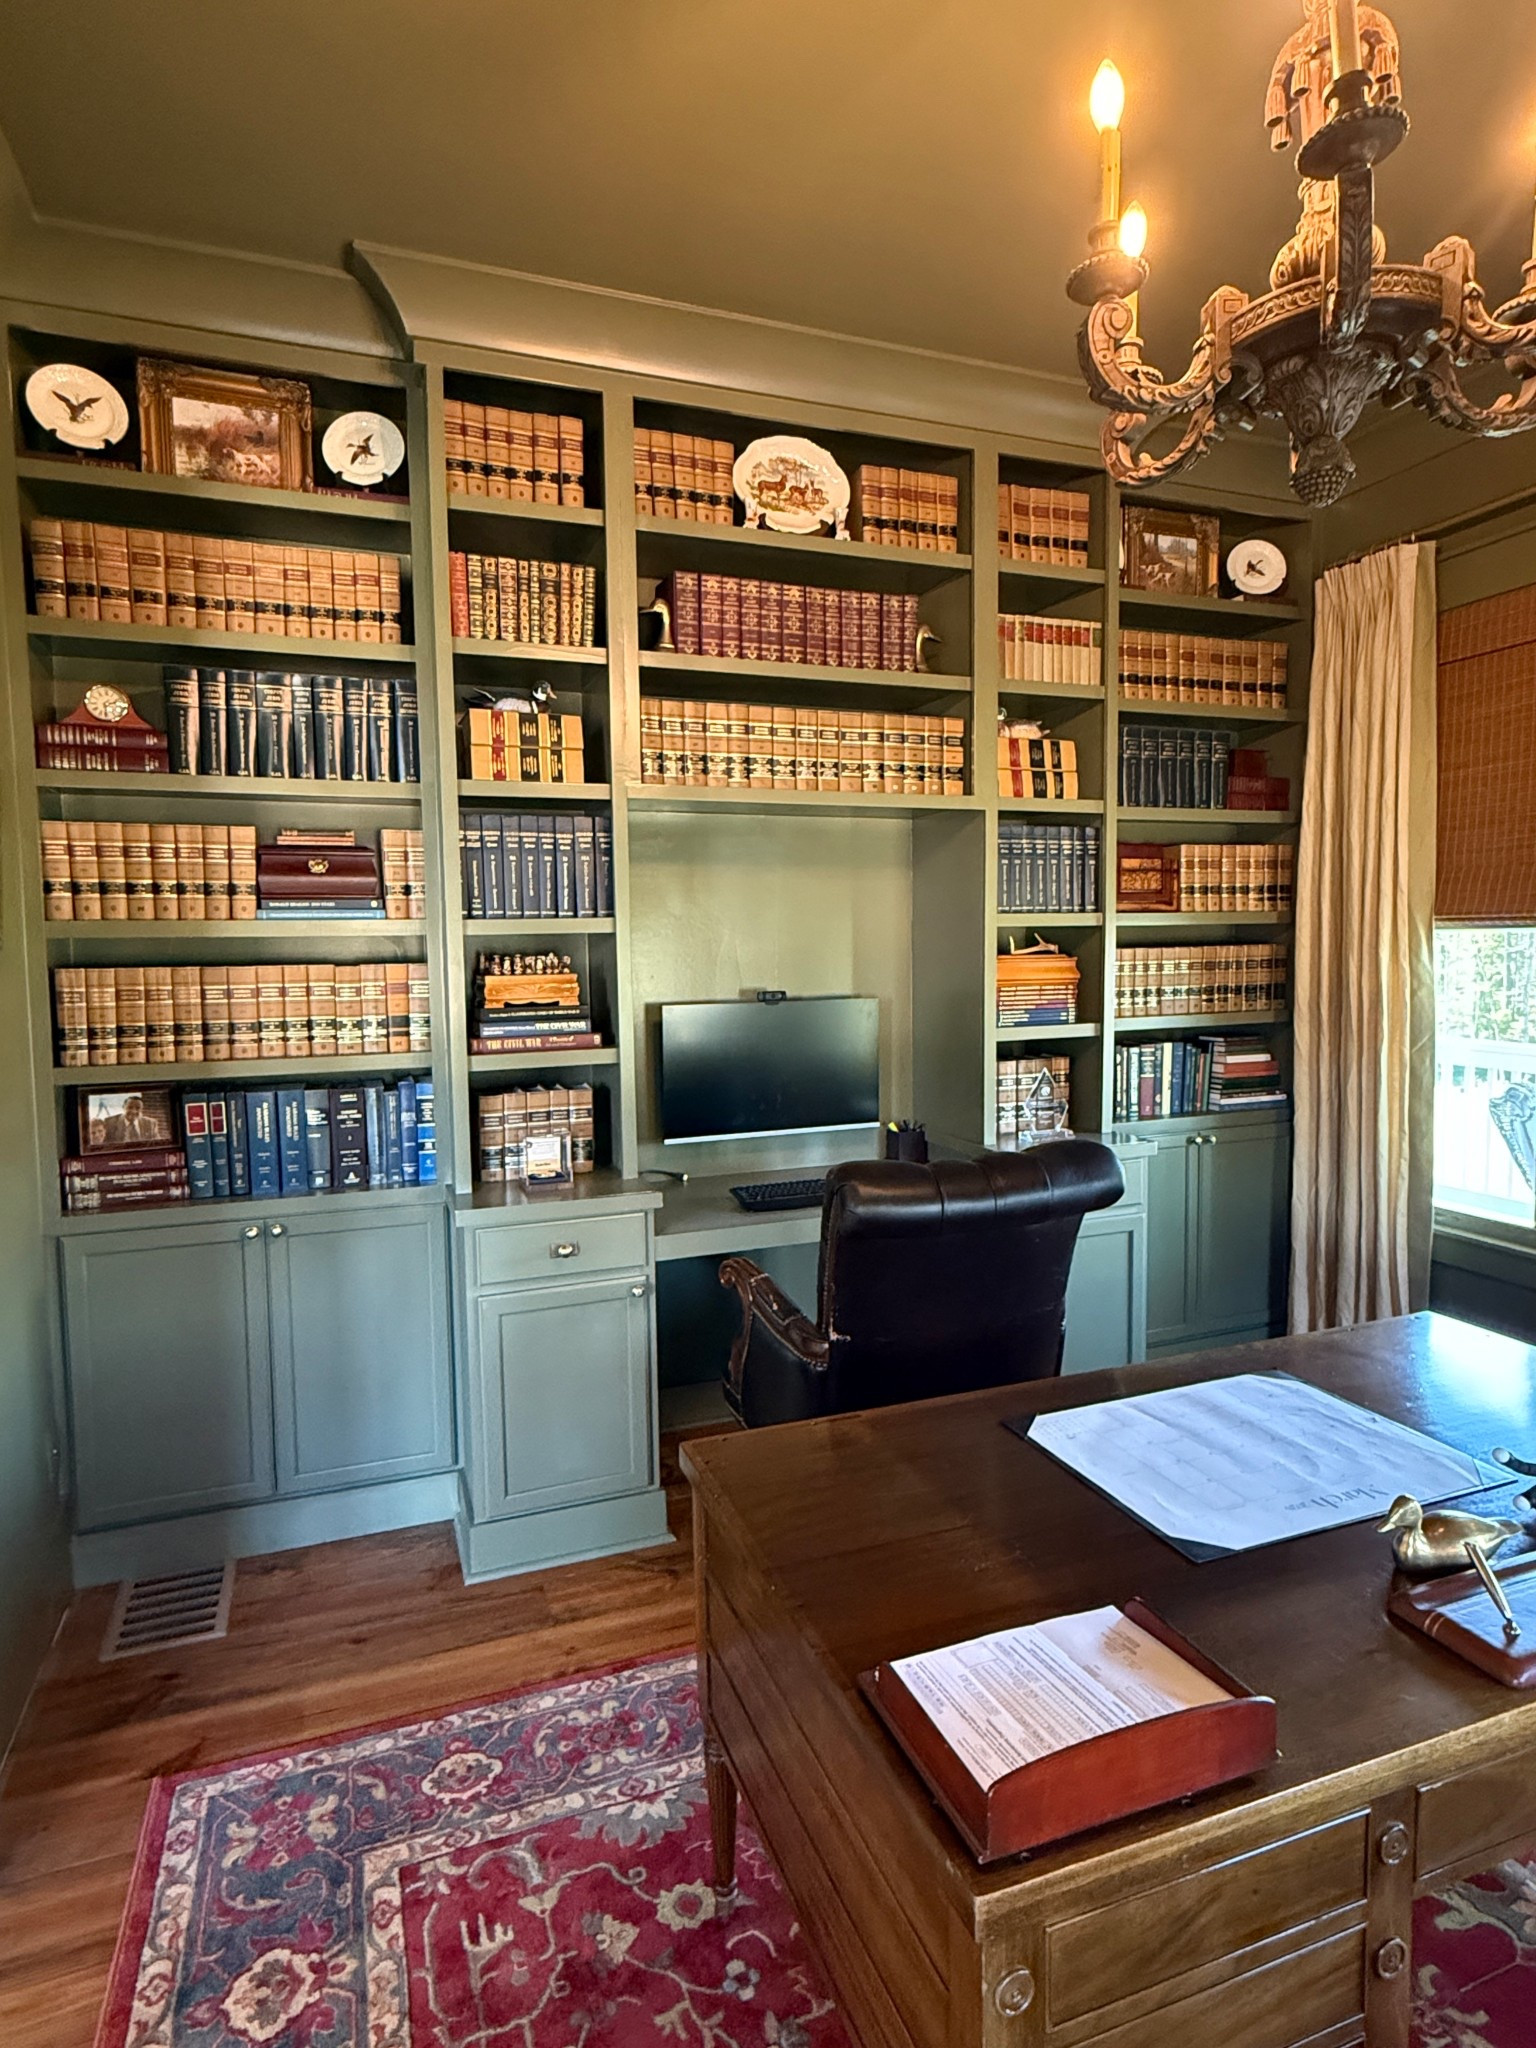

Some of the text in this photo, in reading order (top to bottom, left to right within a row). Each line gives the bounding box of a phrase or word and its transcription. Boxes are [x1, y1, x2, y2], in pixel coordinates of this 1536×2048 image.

[535, 1022, 549, 1030] THE
[550, 1022, 568, 1030] CIVIL
[569, 1021, 586, 1029] WAR
[486, 1040, 502, 1050] THE
[503, 1039, 525, 1049] CIVIL
[525, 1038, 542, 1048] WAR
[1311, 1484, 1390, 1509] March
